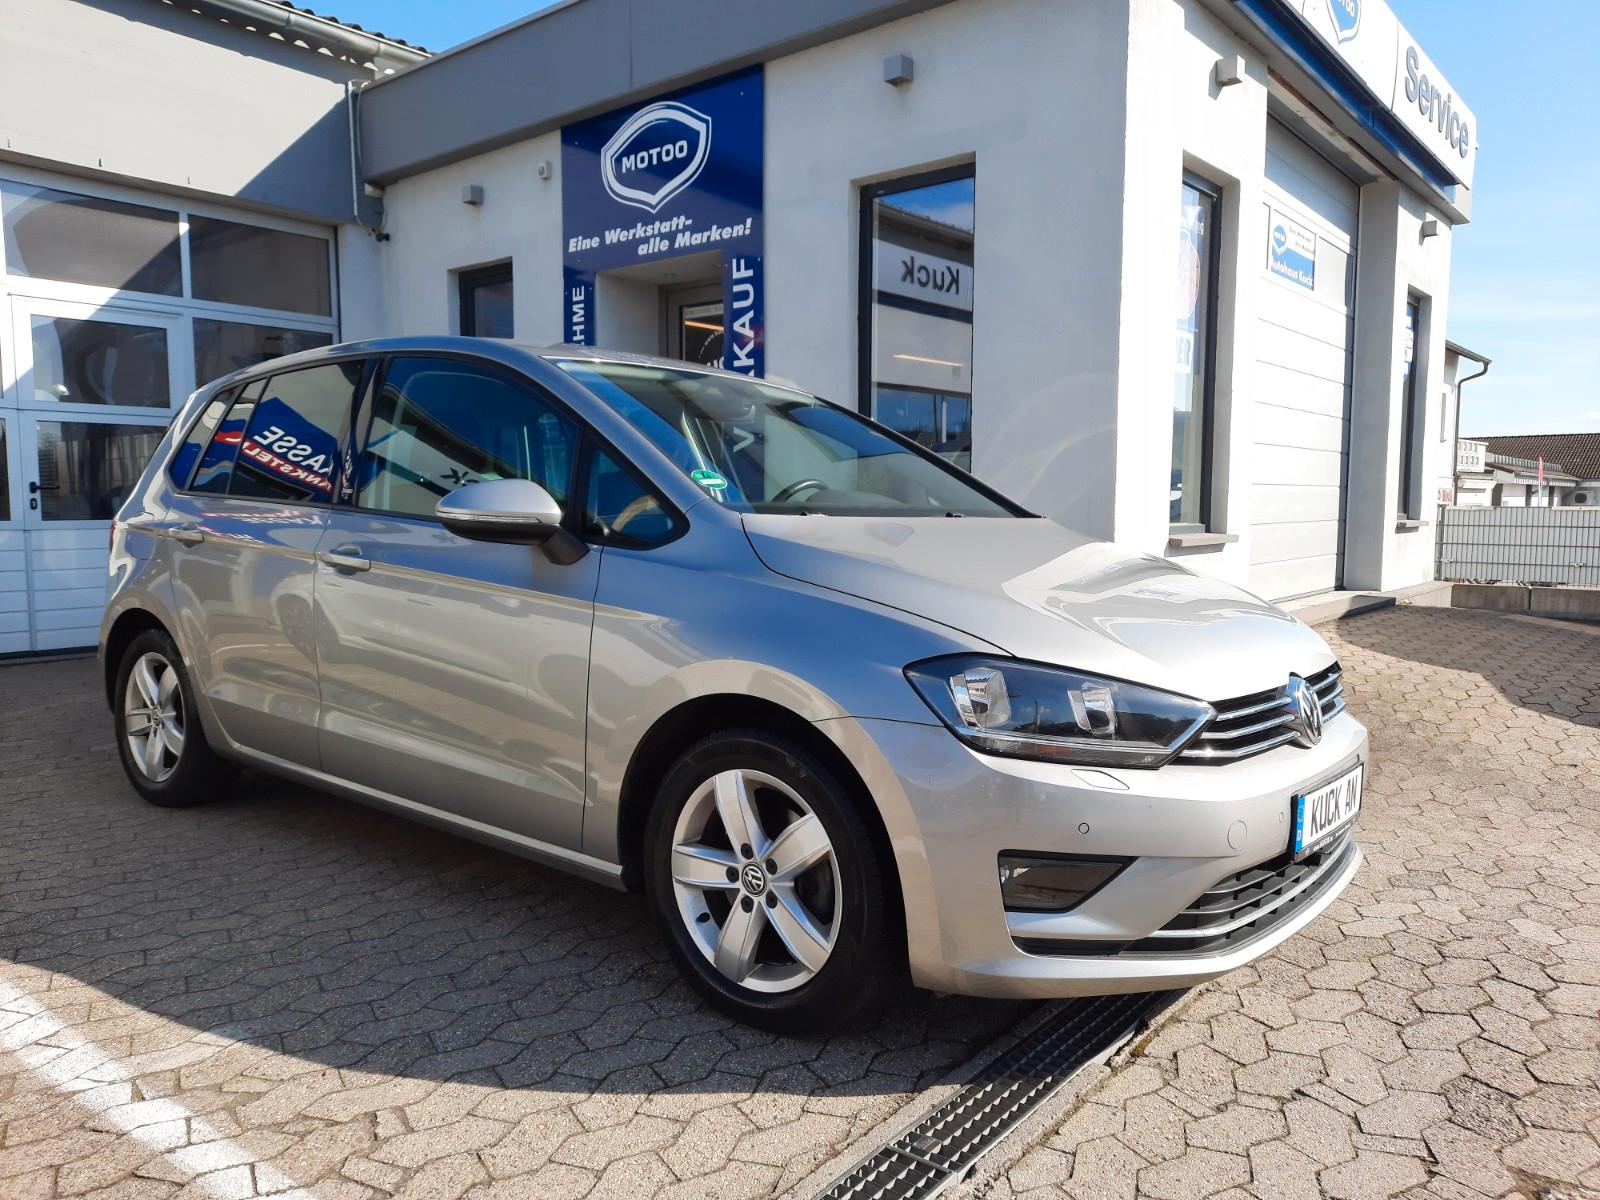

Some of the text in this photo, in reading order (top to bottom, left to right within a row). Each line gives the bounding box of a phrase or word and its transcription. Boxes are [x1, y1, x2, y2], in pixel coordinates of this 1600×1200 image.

[1404, 45, 1470, 159] Service
[621, 139, 688, 173] MOTOO
[568, 215, 693, 253] Eine Werkstatt-
[638, 217, 752, 256] alle Marken!
[572, 285, 585, 345] HME
[1310, 774, 1359, 837] KUCK AN
